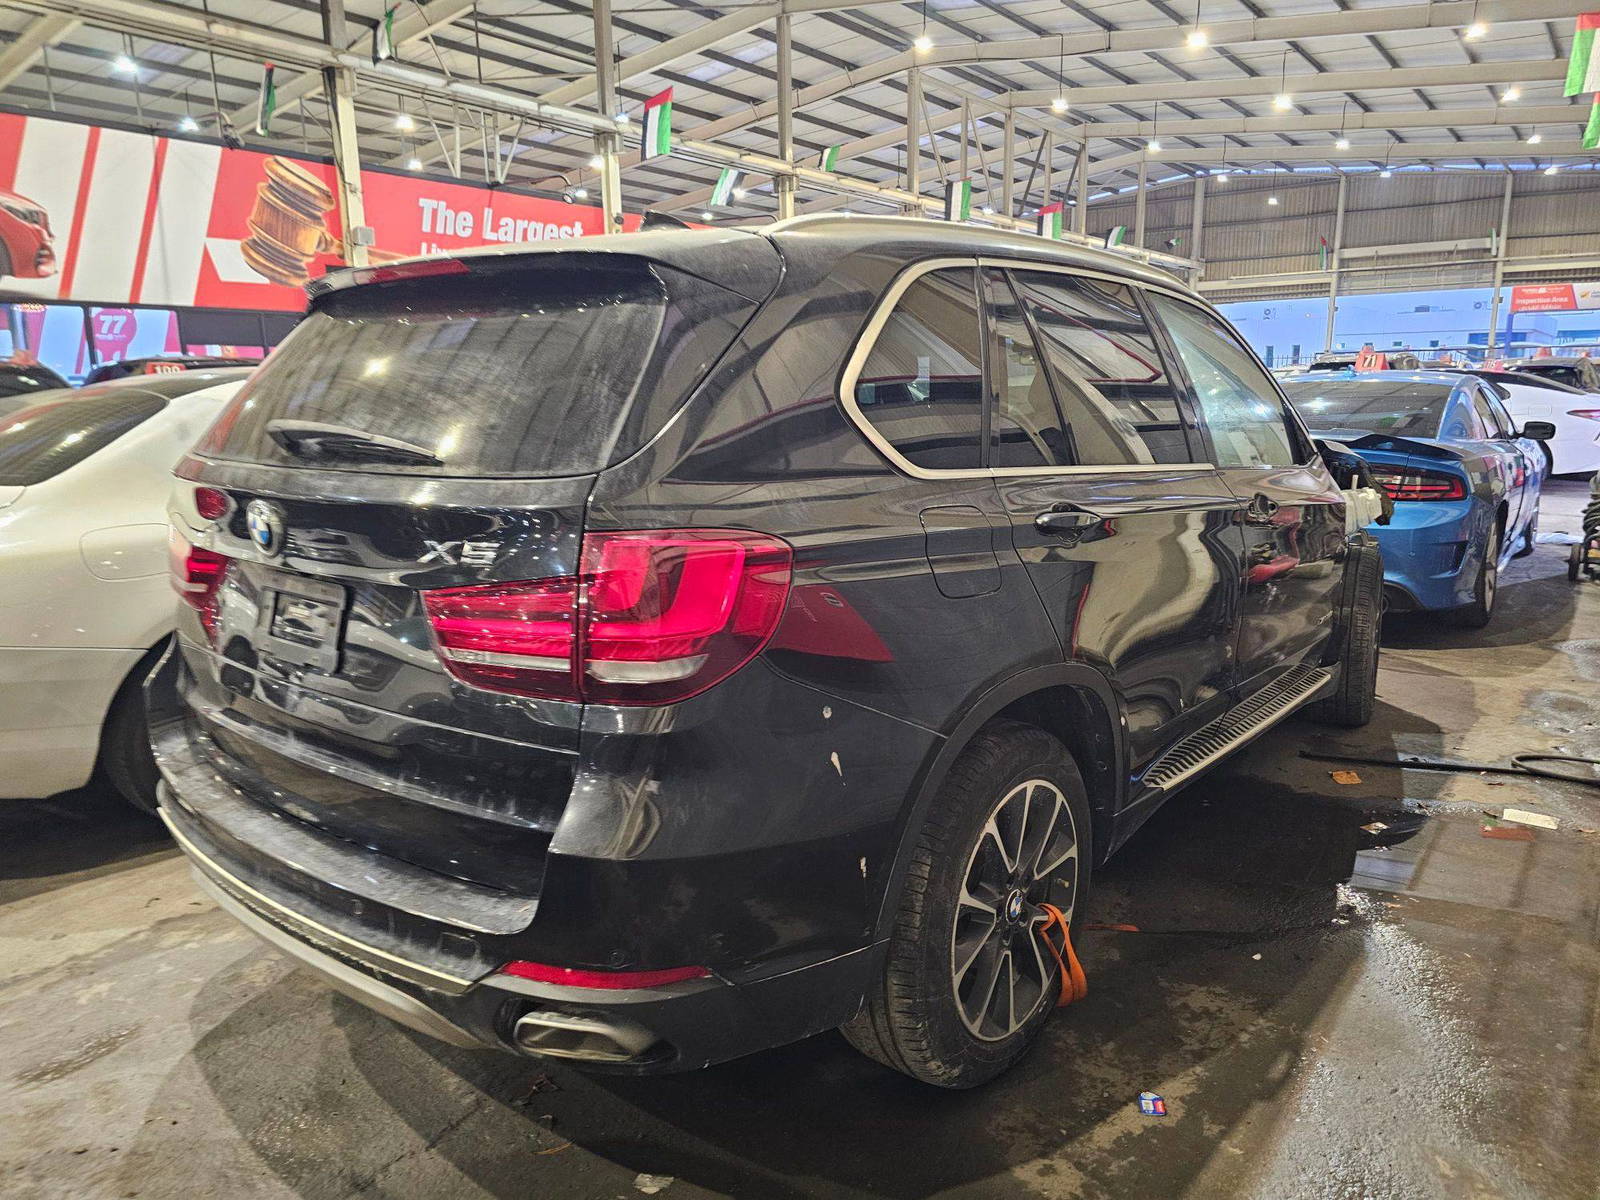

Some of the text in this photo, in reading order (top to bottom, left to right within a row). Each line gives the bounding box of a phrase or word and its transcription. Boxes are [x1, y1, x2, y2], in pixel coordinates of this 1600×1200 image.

[418, 197, 584, 243] The Largest
[99, 314, 128, 335] 77
[1363, 354, 1376, 368] 71
[416, 539, 501, 567] X5
